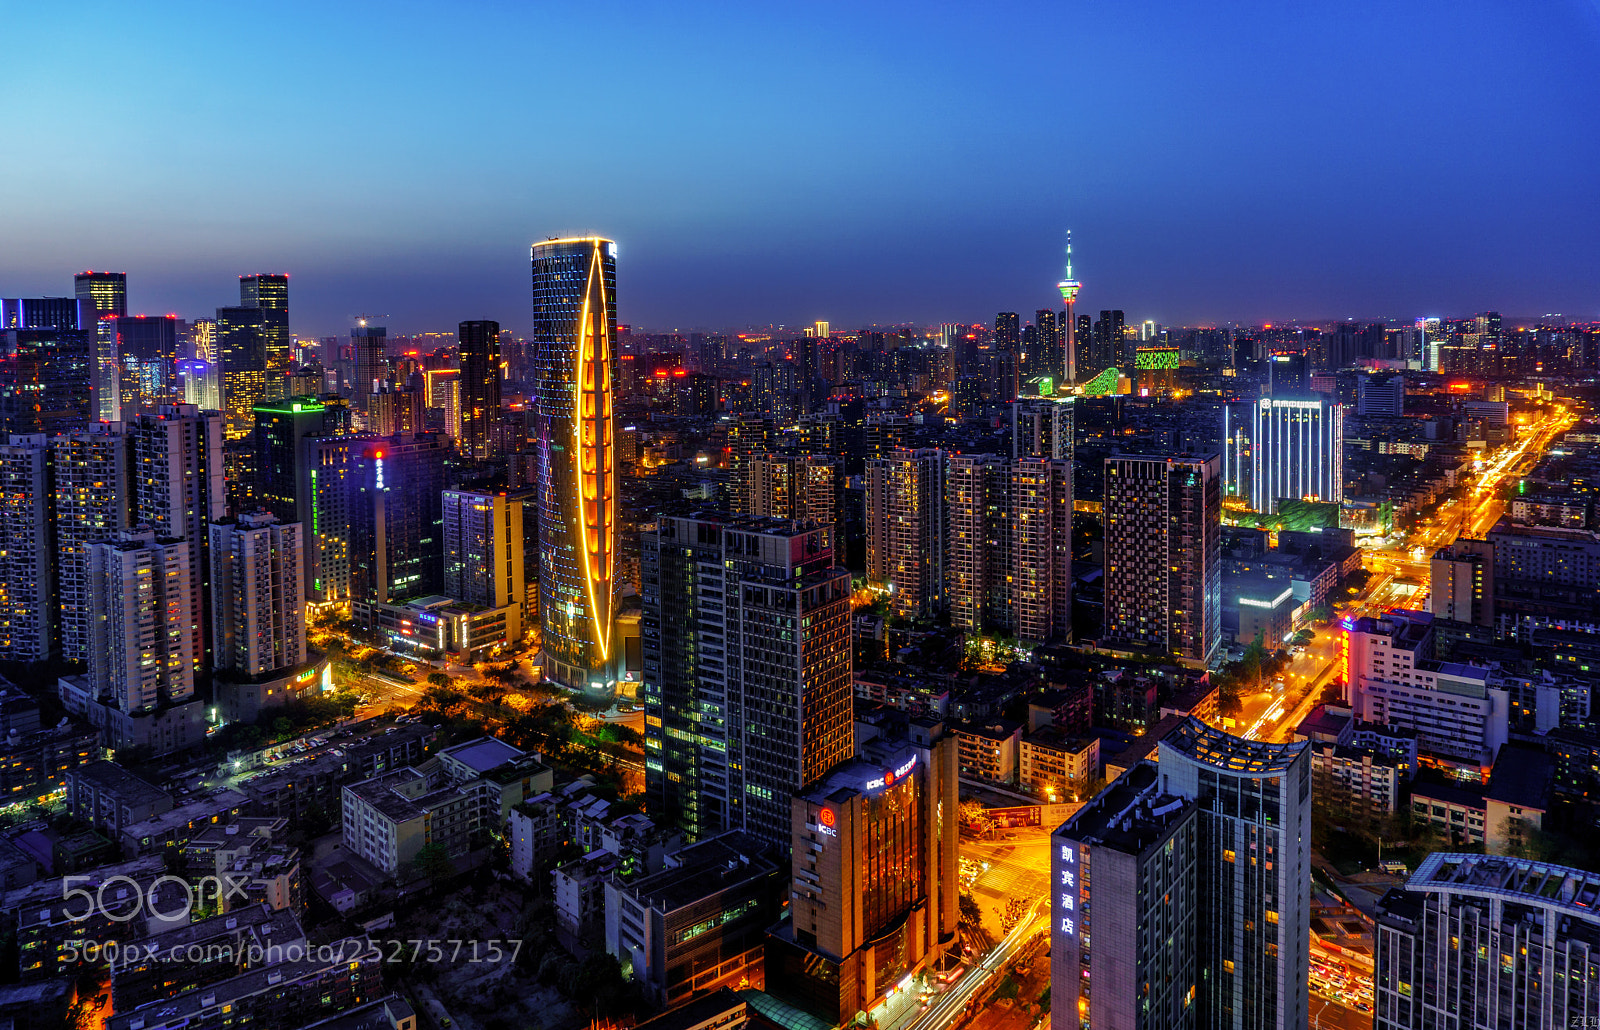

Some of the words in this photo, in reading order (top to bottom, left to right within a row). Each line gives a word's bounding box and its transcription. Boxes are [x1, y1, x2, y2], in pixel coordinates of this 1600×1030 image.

[866, 777, 884, 790] ICBC
[818, 823, 837, 838] ICBC
[1061, 845, 1075, 935] 凯宾酒店
